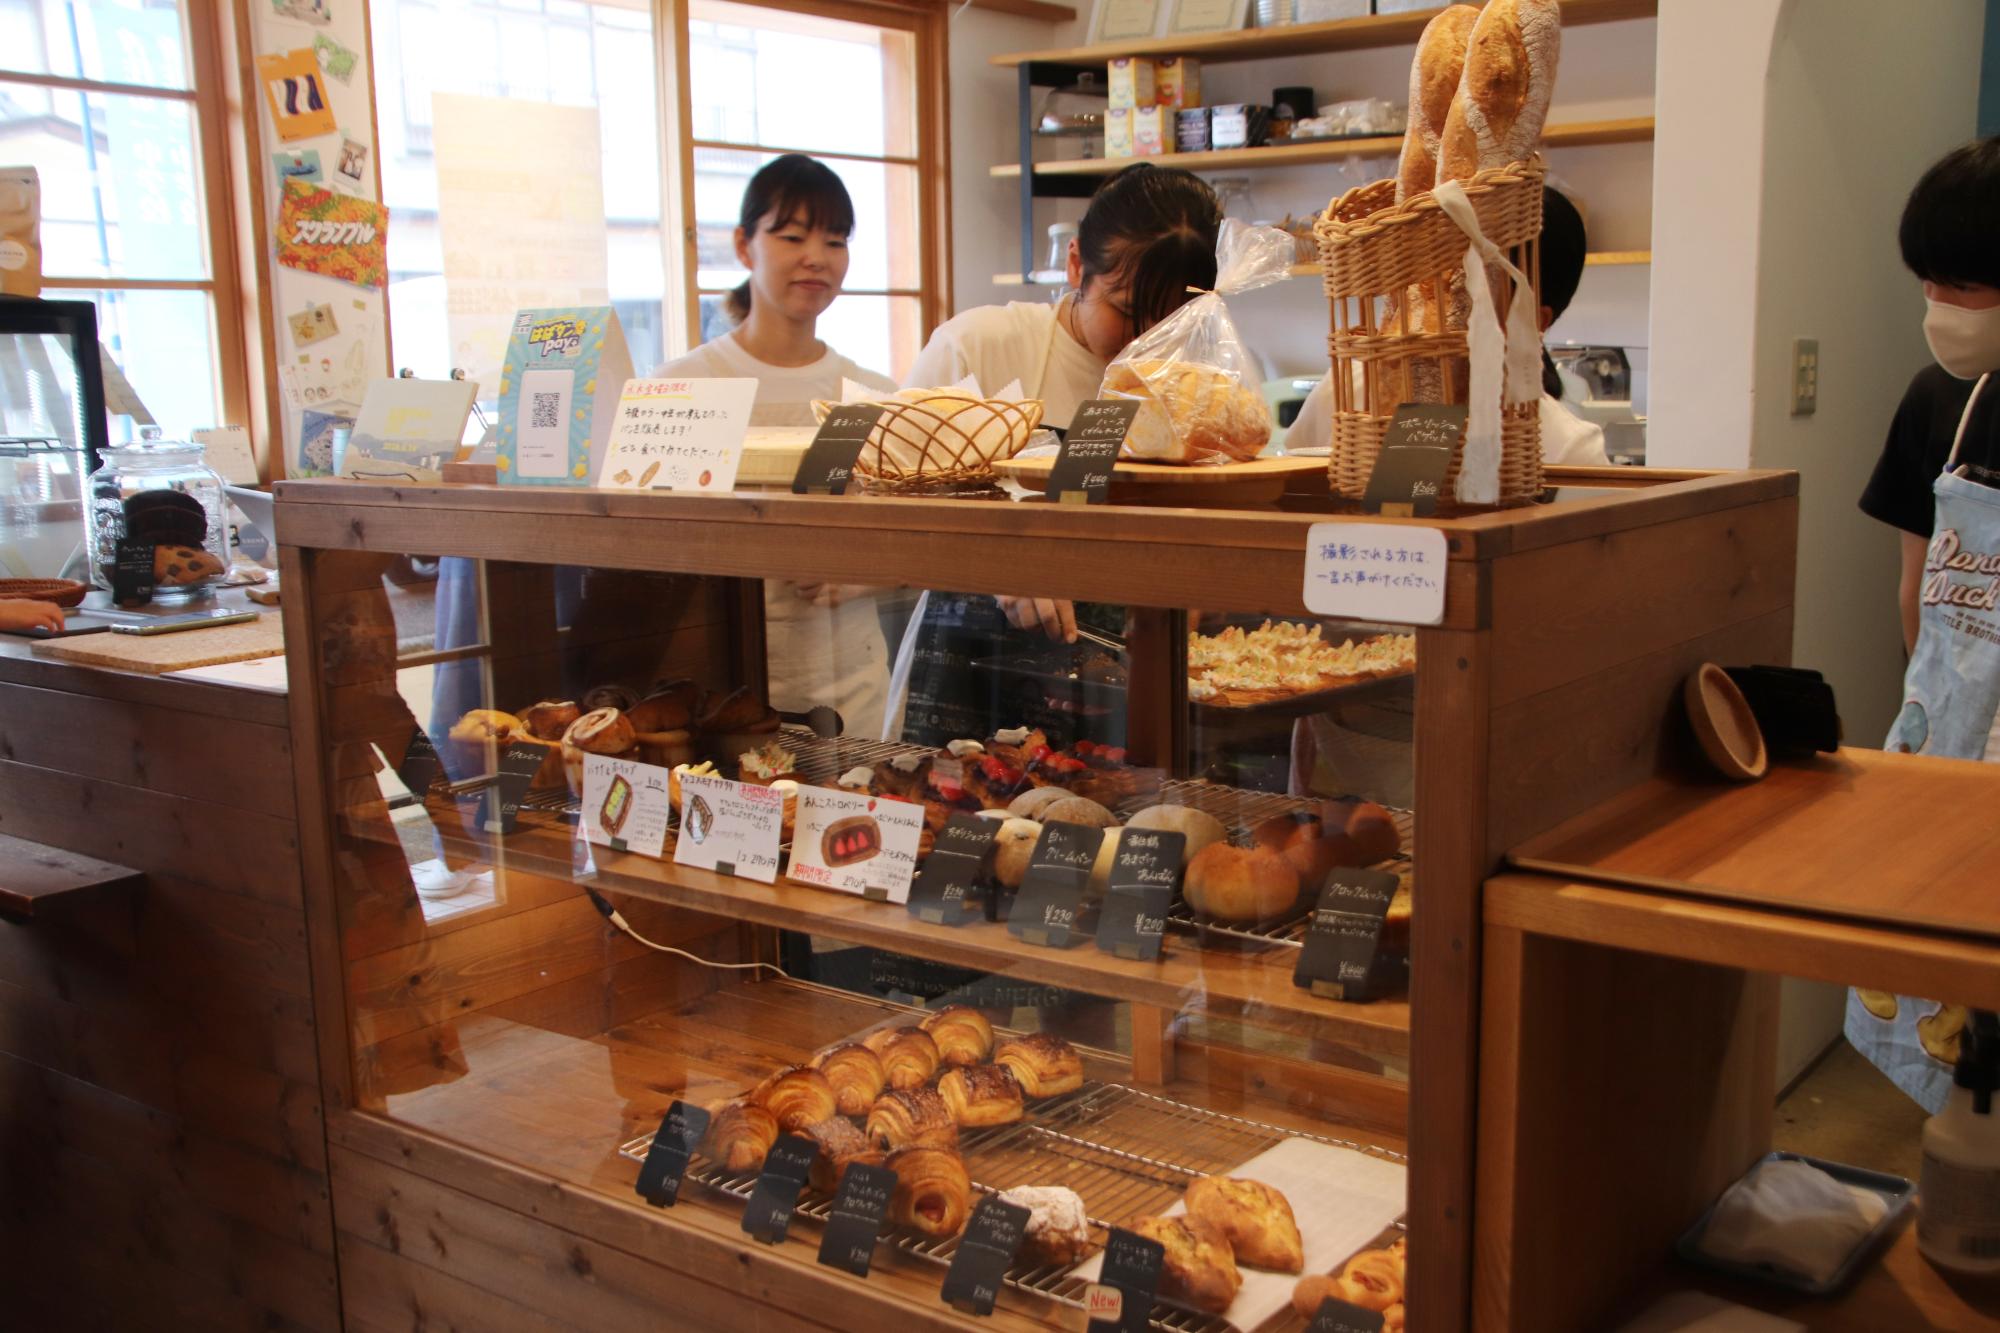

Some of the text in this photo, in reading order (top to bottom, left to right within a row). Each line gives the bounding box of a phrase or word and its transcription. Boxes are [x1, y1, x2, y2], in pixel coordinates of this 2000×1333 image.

[291, 220, 376, 244] スクランブル
[1406, 430, 1449, 442] バゲット
[1923, 571, 1998, 611] Duck
[804, 795, 865, 809] あんこストロベリー
[1120, 853, 1157, 866] あまざけ
[1138, 868, 1175, 883] あんぱん
[1045, 904, 1072, 924] ¥230
[1135, 913, 1164, 934] ¥200
[1090, 1291, 1120, 1307] New!
